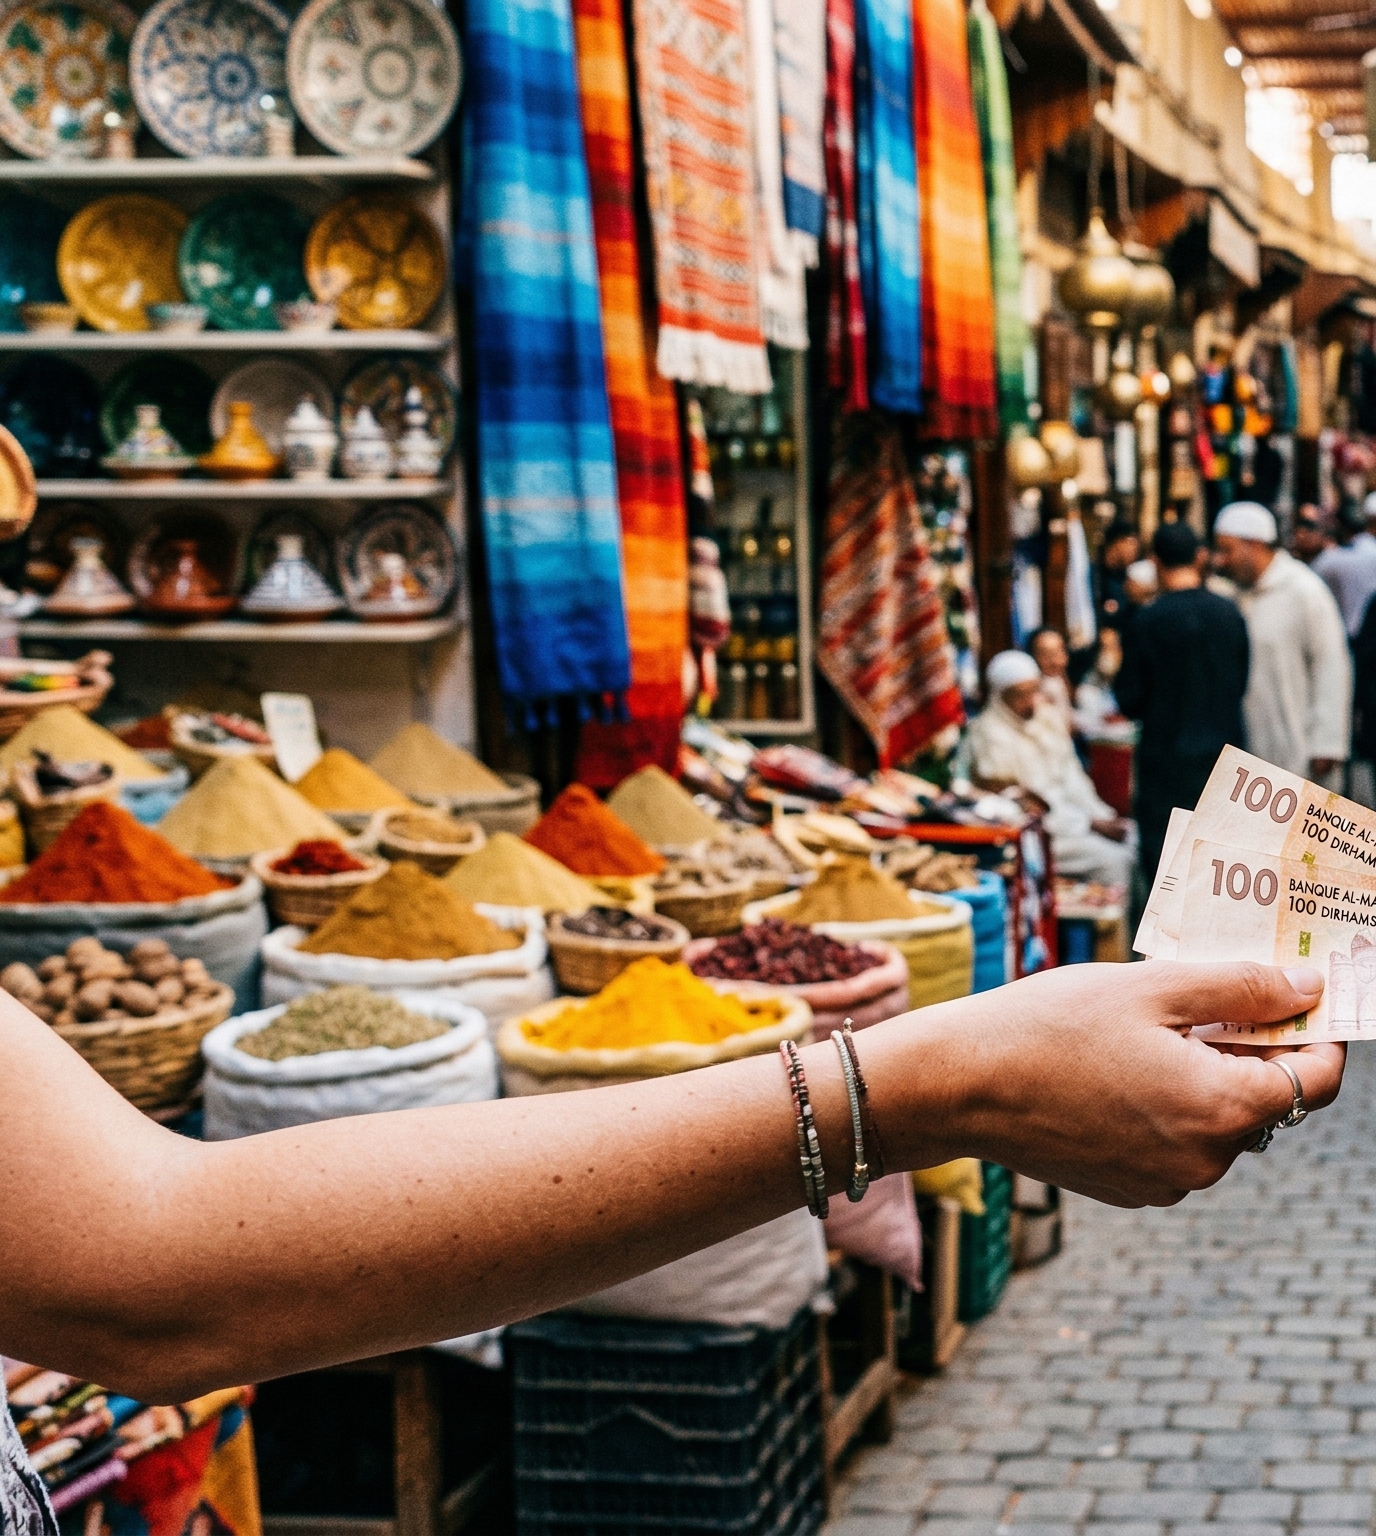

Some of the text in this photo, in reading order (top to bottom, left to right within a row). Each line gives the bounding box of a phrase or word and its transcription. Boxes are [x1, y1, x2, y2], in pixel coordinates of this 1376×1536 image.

[1230, 766, 1298, 823] 100
[1301, 819, 1329, 843] 100
[1306, 803, 1357, 836] BANQUE
[1211, 859, 1278, 906] 100
[1289, 878, 1340, 900] BANQUE
[1288, 895, 1376, 927] 100 DIRHAMS
